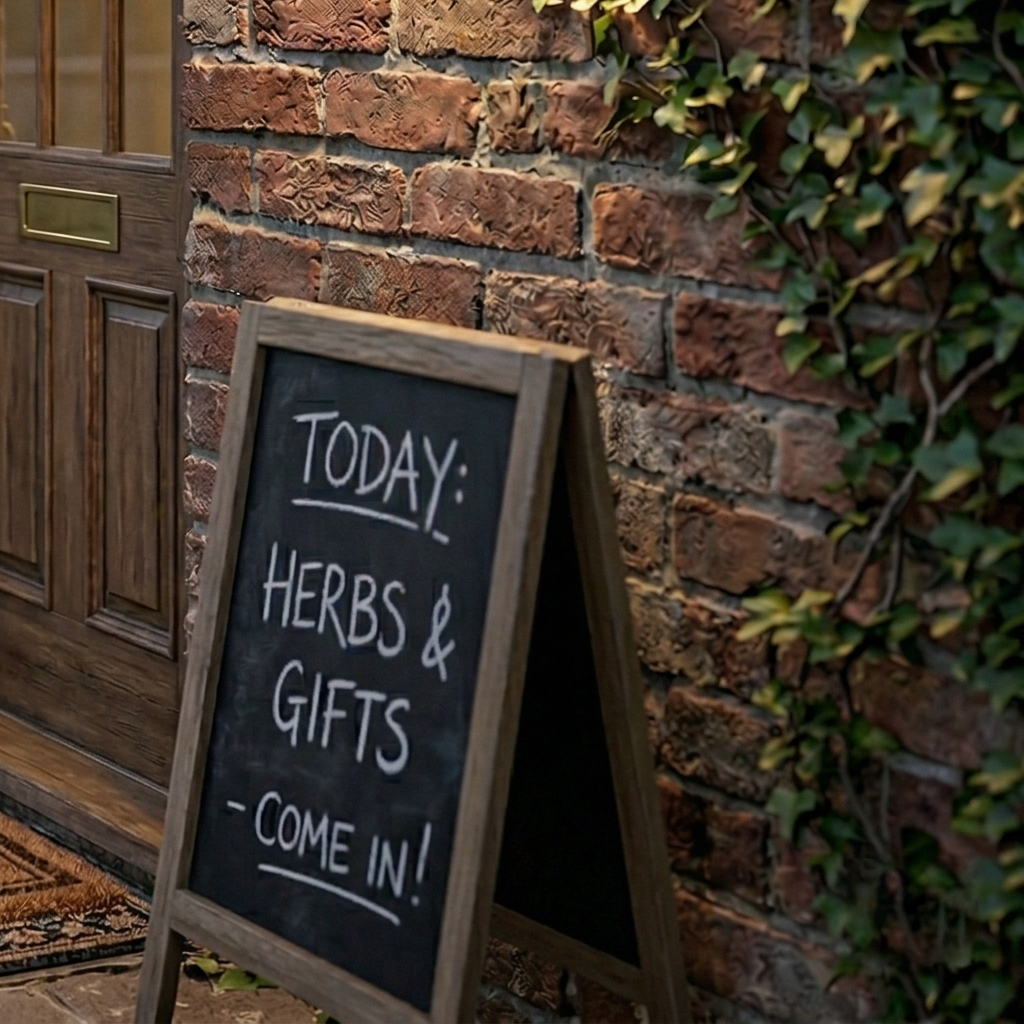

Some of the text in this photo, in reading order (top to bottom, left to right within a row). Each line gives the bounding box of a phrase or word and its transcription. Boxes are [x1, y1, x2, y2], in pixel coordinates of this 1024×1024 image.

[293, 411, 468, 532] TODAY:
[263, 542, 455, 681] HERBS &
[272, 659, 412, 775] GIFTS
[367, 822, 432, 906] IN!
